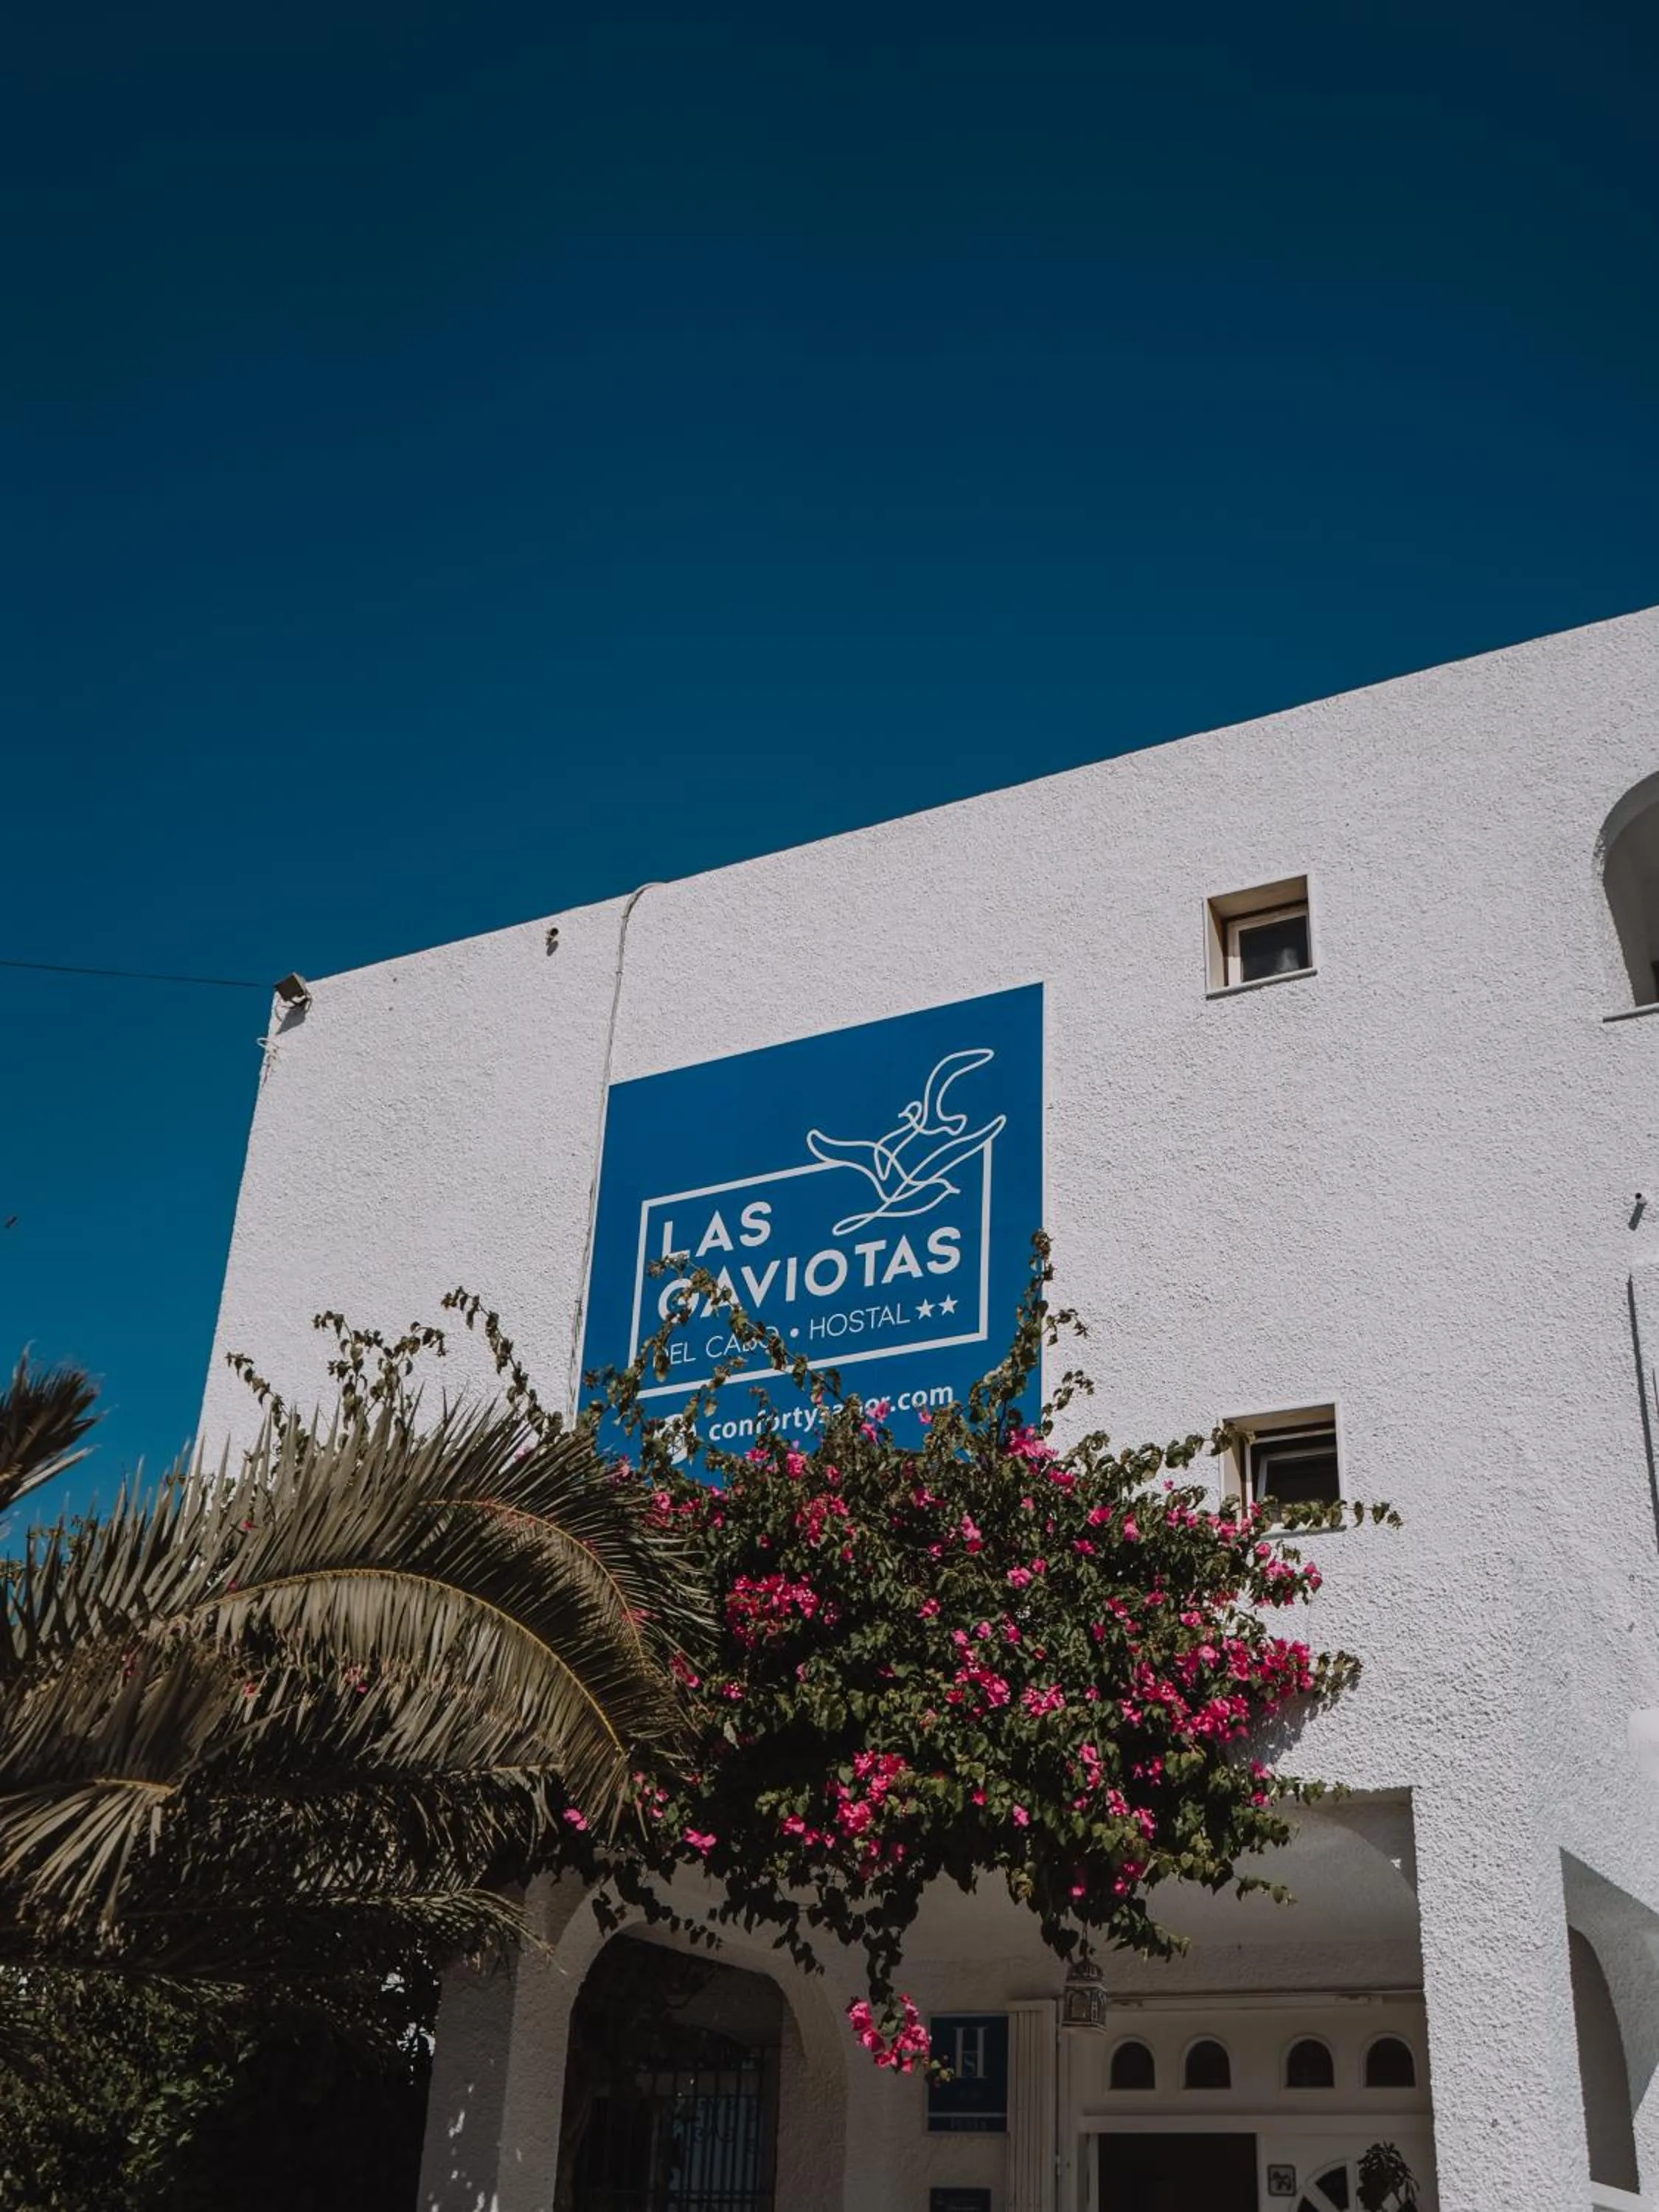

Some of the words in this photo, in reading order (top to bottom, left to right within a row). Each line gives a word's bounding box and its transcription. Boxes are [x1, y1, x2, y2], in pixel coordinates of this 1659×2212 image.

[662, 1201, 772, 1260] LAS
[657, 1226, 961, 1324] GAVIOTAS
[809, 1302, 911, 1340] HOSTAL
